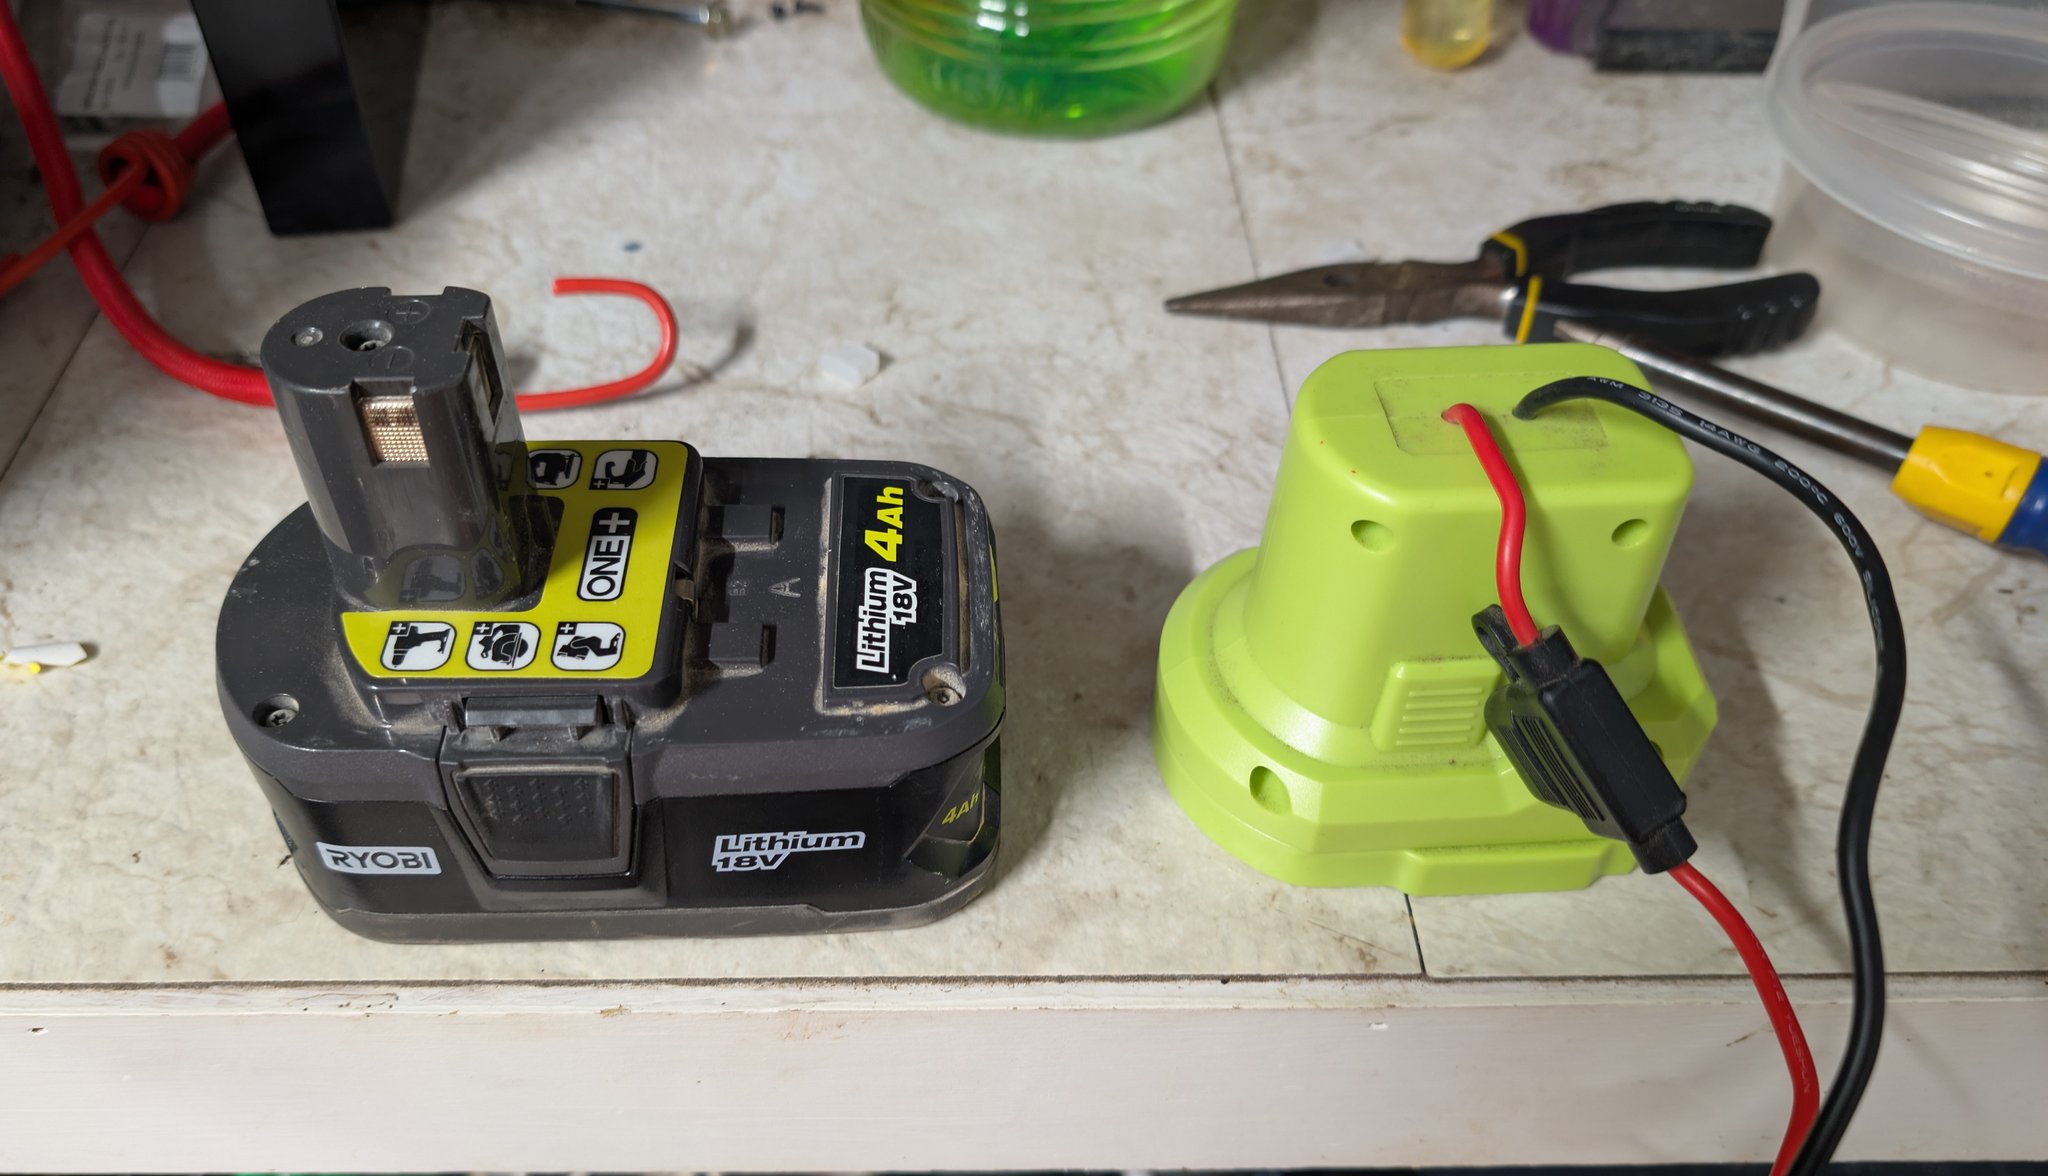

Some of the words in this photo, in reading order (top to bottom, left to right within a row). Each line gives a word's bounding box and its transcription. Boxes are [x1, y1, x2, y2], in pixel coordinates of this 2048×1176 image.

[864, 485, 904, 563] 4Ah
[892, 574, 914, 623] 18V
[859, 569, 888, 670] Lithium
[941, 791, 979, 825] 4Ah
[325, 848, 433, 869] RYOBI
[719, 833, 861, 853] Lithium
[717, 853, 784, 869] 18V
